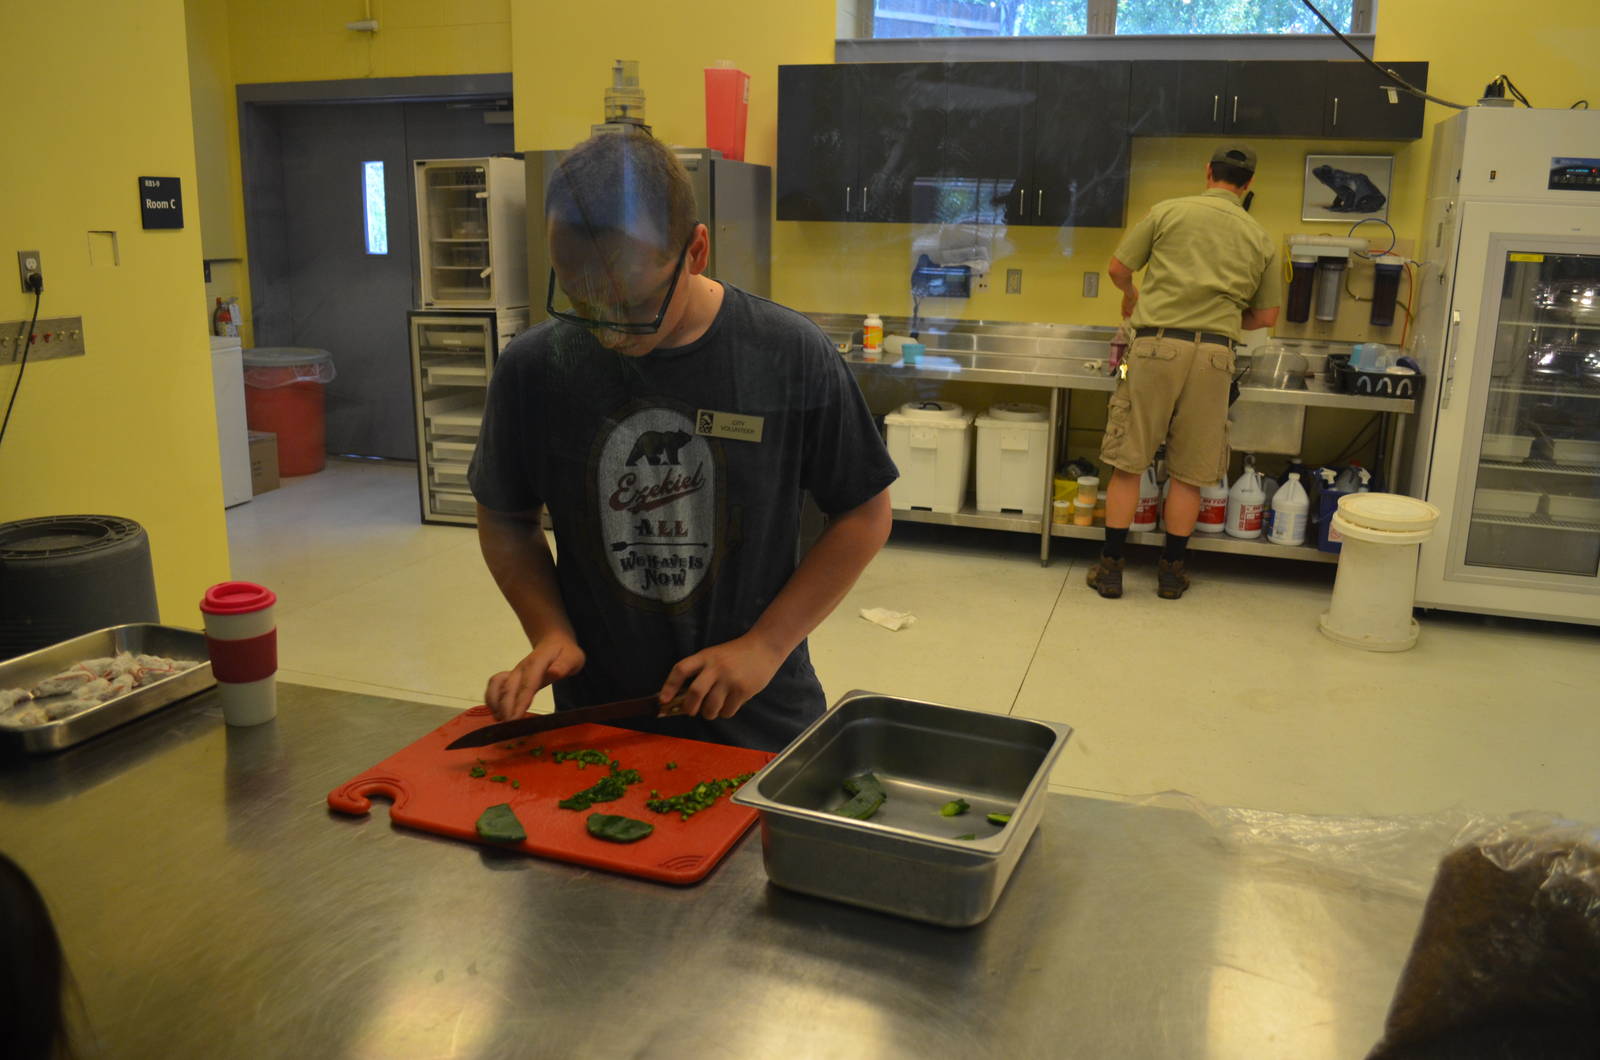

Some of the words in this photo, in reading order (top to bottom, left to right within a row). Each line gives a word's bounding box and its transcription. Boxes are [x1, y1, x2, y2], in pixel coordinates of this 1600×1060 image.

[146, 199, 169, 209] Room
[170, 198, 176, 209] C
[608, 461, 707, 514] Ezekiel
[633, 518, 689, 538] ALL
